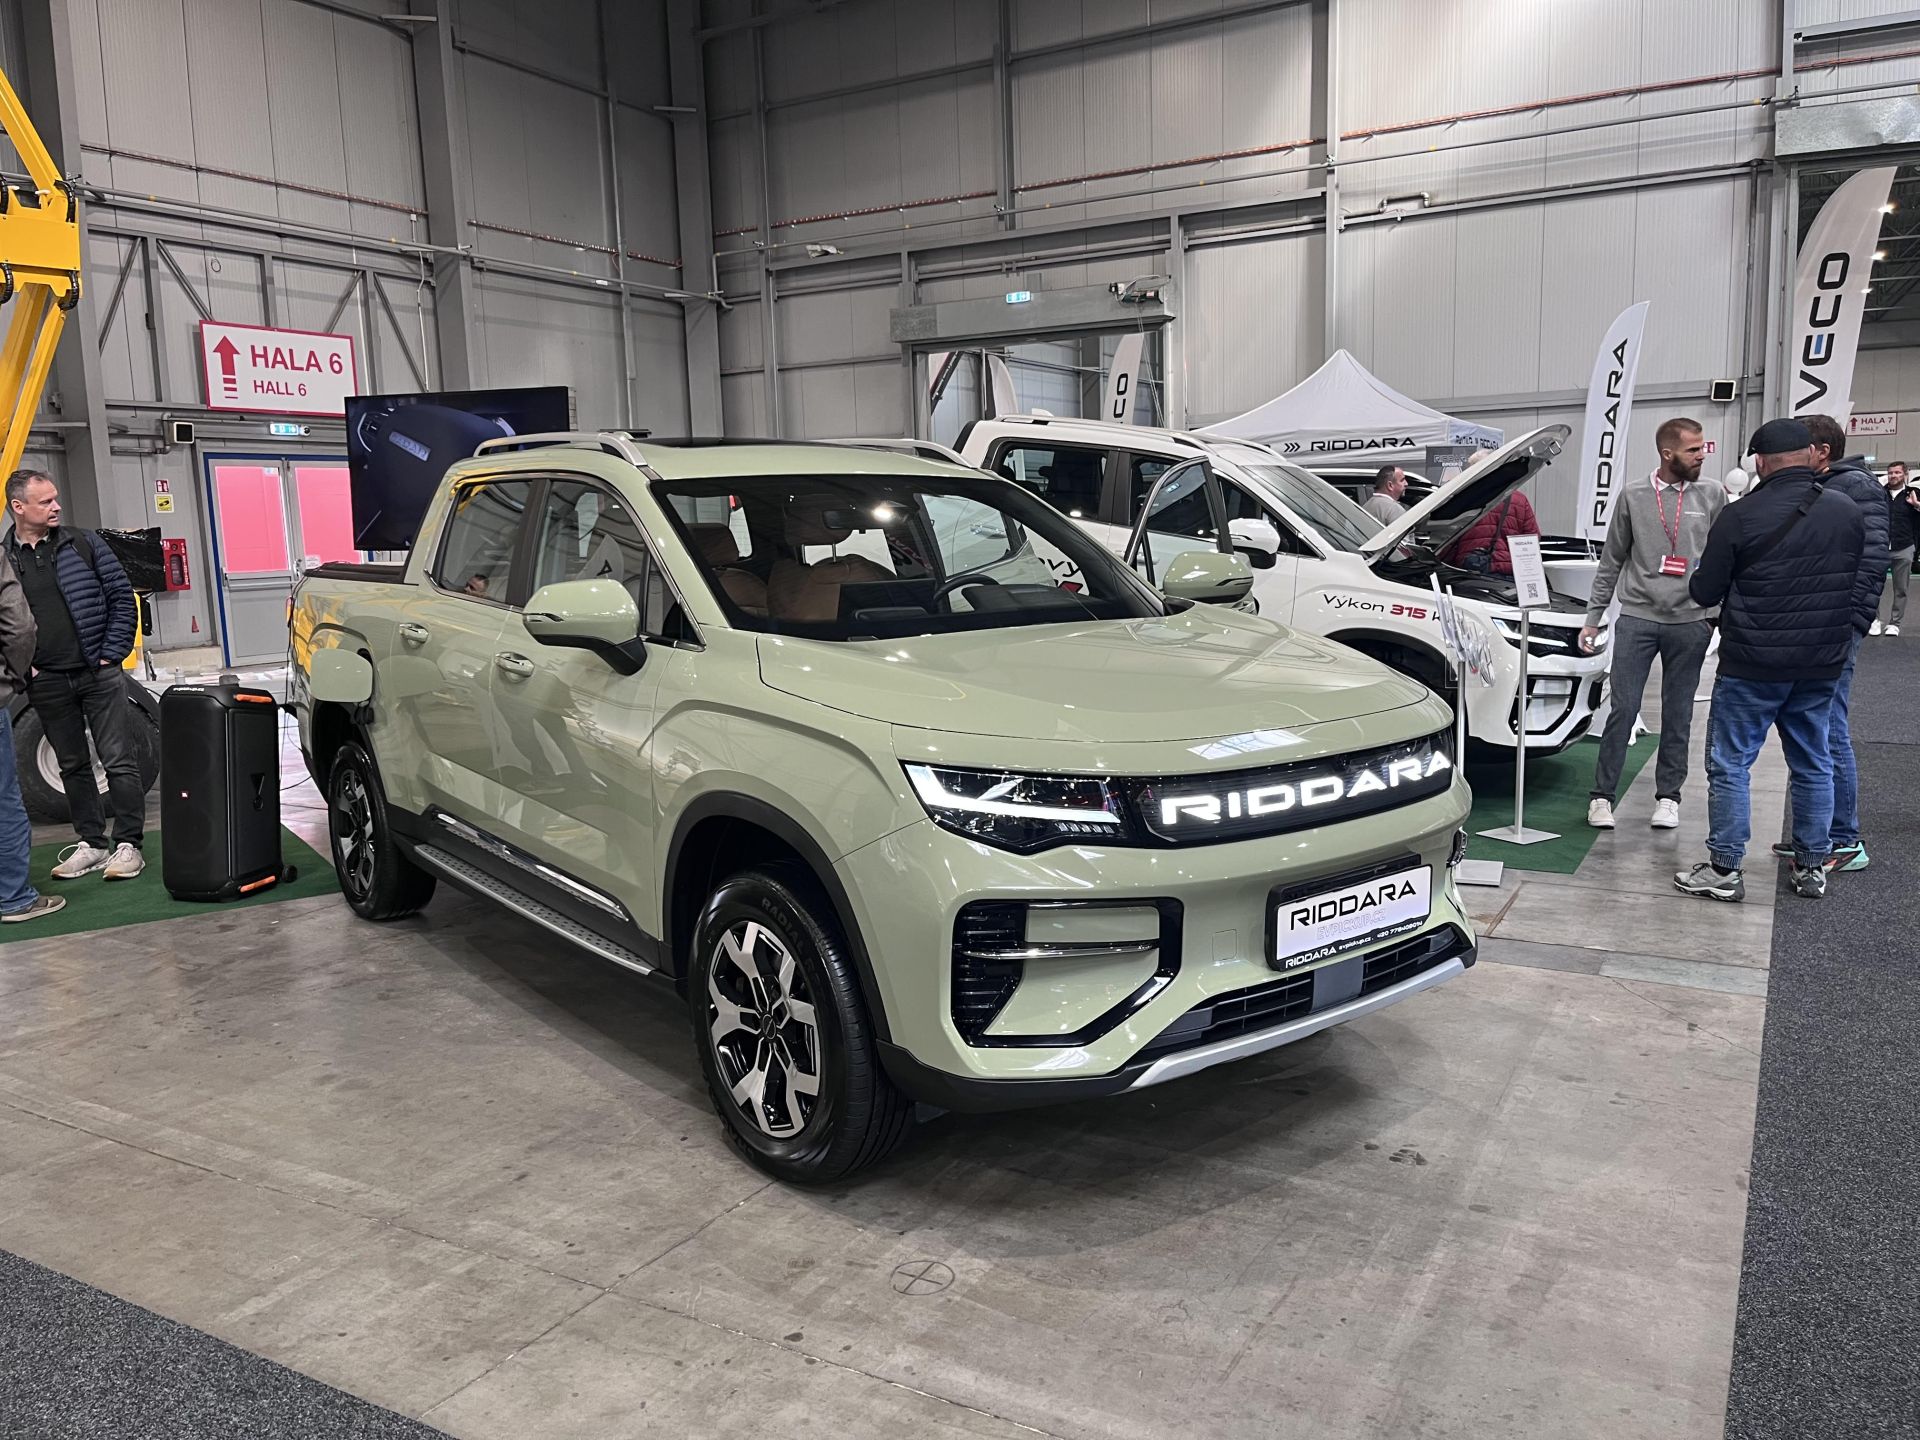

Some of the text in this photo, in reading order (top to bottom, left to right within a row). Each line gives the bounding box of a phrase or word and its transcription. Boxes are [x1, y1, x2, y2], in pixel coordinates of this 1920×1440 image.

[1794, 252, 1850, 419] VECO
[250, 345, 343, 374] HALA 6
[253, 380, 307, 396] HALL 6
[1113, 373, 1128, 423] CO
[1593, 338, 1628, 527] RIDDARA
[1861, 416, 1893, 425] HALA 7
[1311, 437, 1416, 451] RIDDARA
[1323, 593, 1385, 613] Výkon
[1390, 604, 1427, 619] 315
[1161, 751, 1450, 825] RIDDARA
[1291, 880, 1416, 930] RIDDARA
[1285, 946, 1337, 969] RIDDARA
